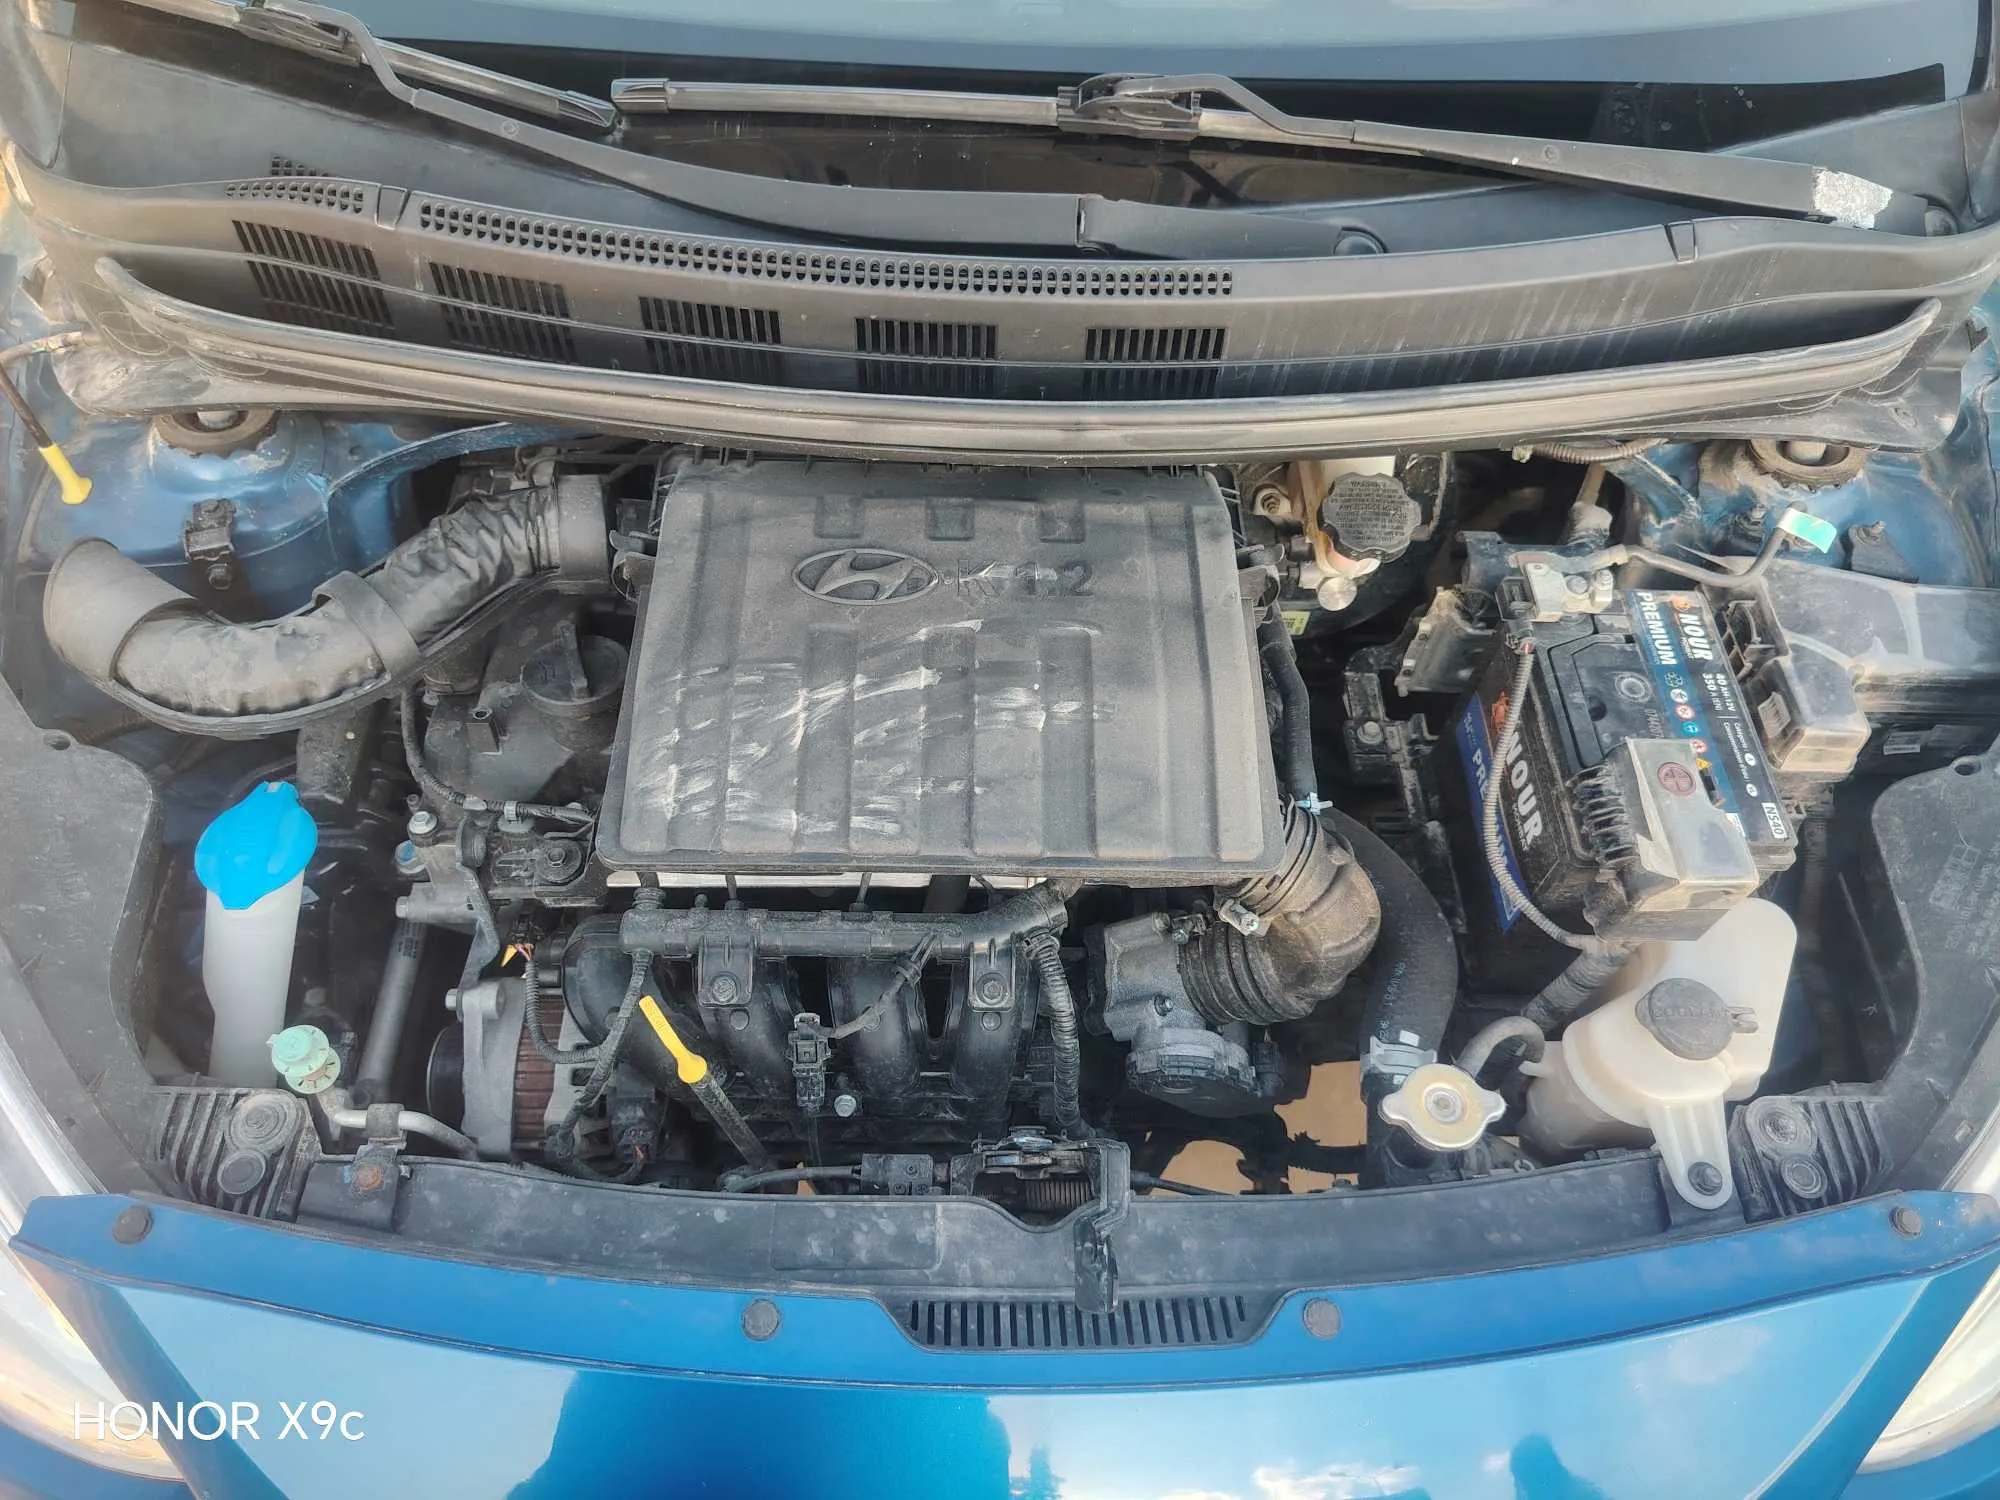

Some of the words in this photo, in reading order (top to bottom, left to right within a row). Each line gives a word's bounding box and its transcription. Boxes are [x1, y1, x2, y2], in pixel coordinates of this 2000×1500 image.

[1636, 592, 1678, 666] PREMIUM
[1679, 612, 1714, 661] NOUR
[1702, 673, 1717, 692] 350
[1505, 730, 1543, 846] NOUR
[1764, 806, 1786, 836] NS40
